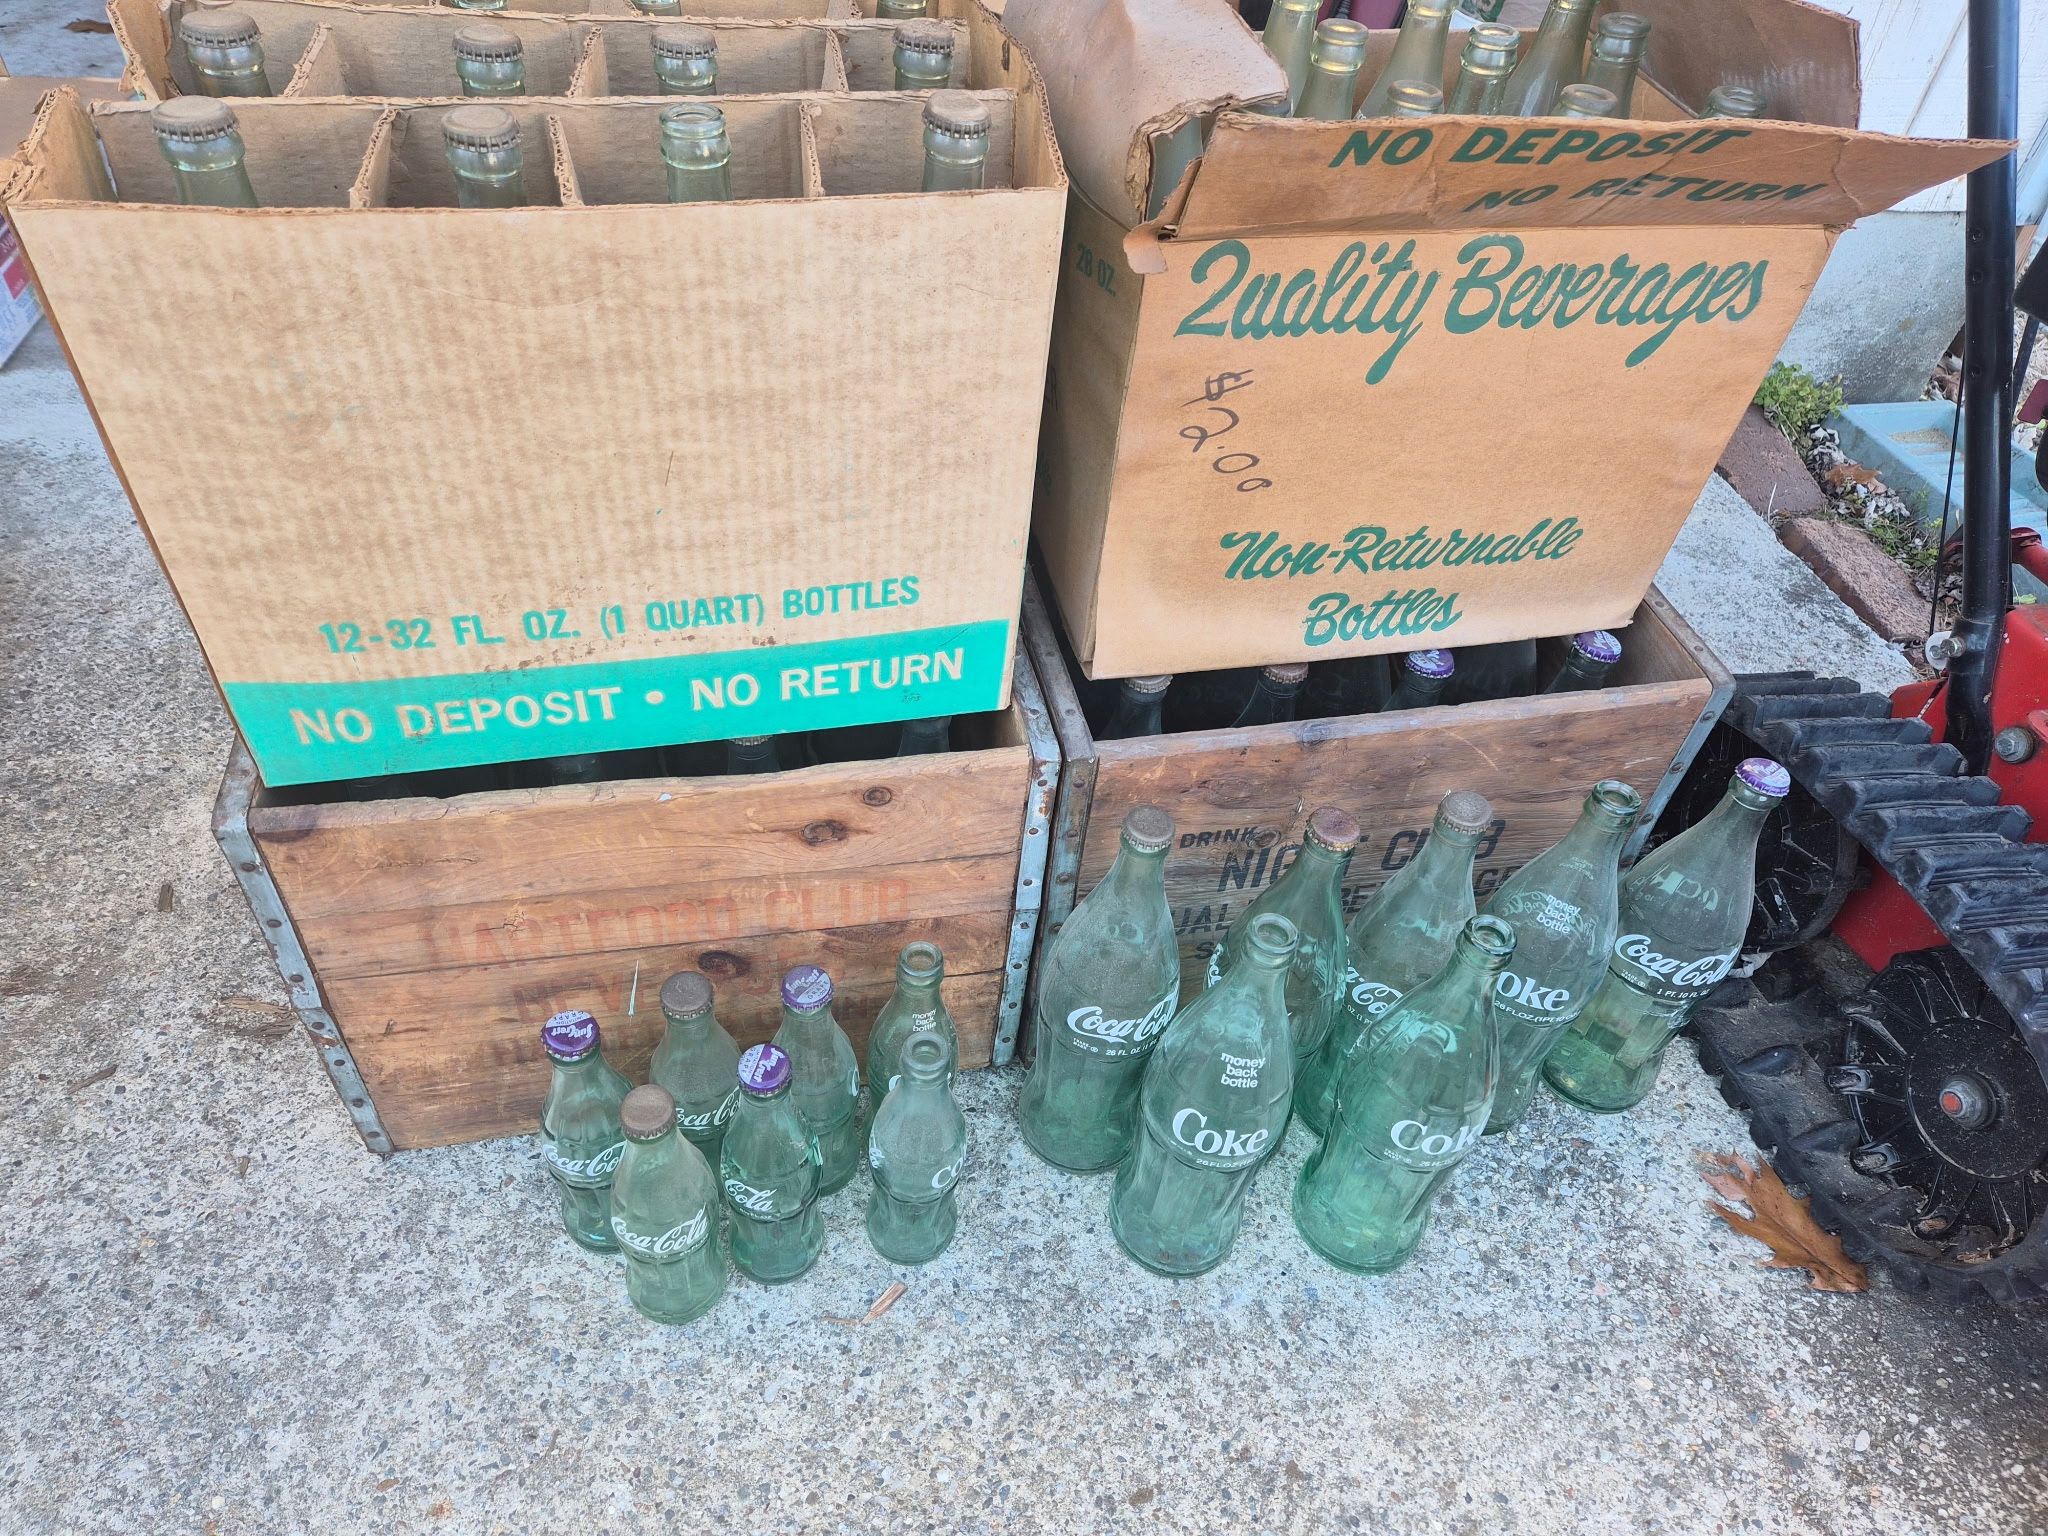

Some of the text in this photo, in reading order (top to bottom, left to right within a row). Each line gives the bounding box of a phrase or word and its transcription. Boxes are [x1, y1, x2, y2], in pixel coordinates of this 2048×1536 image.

[1327, 127, 1753, 168] NO DEPOSIT
[1461, 173, 1828, 213] NO RETURN
[1174, 234, 1770, 383] Quality Beverages
[1220, 516, 1583, 580] Non-Returnable
[319, 618, 436, 654] 12-32
[522, 607, 582, 642] OZ.
[601, 603, 626, 641] (1
[645, 593, 765, 632] QUART)
[782, 575, 920, 620] BOTTLES
[1302, 587, 1463, 647] Bottles
[288, 647, 965, 746] NO DEPOSIT NO RETURN
[1180, 826, 1258, 849] DRINK
[1545, 905, 1571, 924] back
[1546, 894, 1581, 916] money
[1536, 912, 1571, 935] bottle
[1496, 971, 1570, 1012] oke
[912, 1008, 937, 1019] money
[912, 1021, 937, 1032] bottle
[915, 1017, 935, 1027] back
[1220, 1052, 1266, 1068] money
[1226, 1063, 1258, 1078] back
[1220, 1073, 1258, 1089] bottle
[1172, 1108, 1269, 1157] Coke
[725, 1179, 778, 1212] Cola
